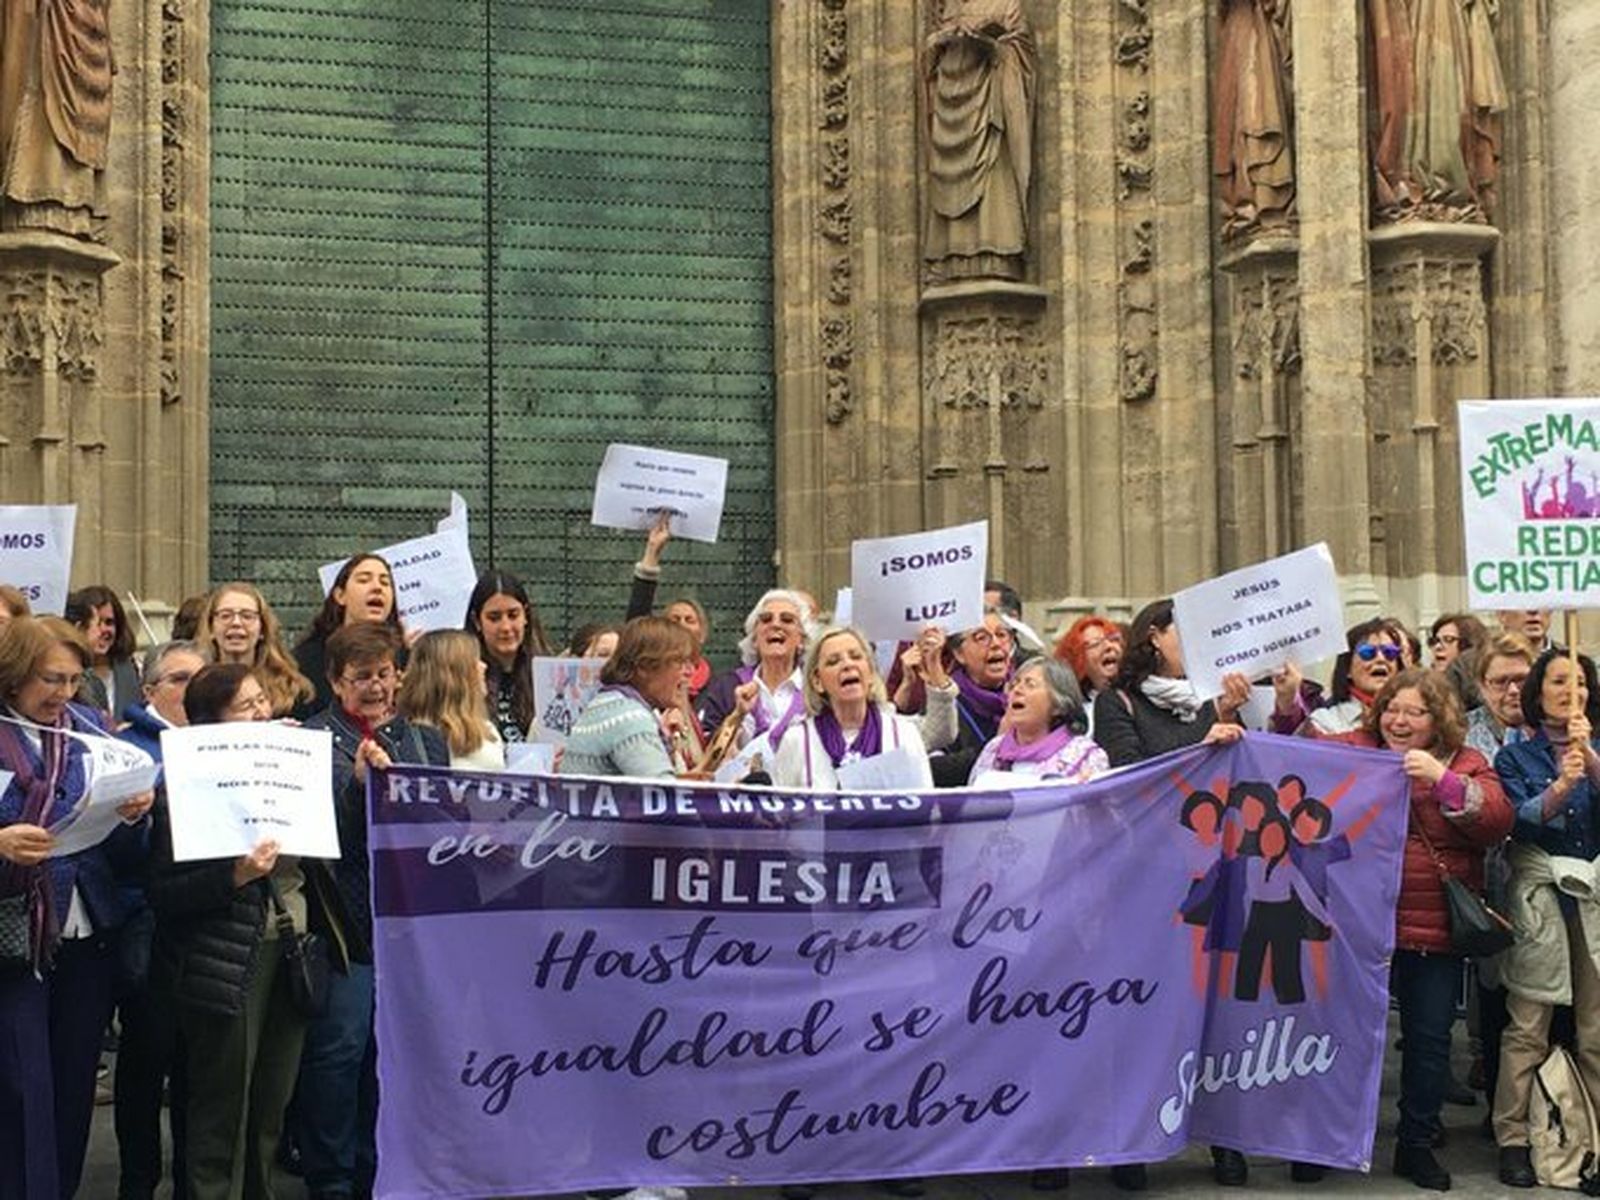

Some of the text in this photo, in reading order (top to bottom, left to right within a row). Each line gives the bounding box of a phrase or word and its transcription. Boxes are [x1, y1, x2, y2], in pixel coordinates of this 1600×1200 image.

[1469, 413, 1600, 498] EXTREMA
[0, 533, 46, 549] MOS
[393, 550, 442, 569] ALDAD
[881, 545, 973, 577] ¡SOMOS
[1474, 561, 1600, 594] CRISTIA
[399, 599, 440, 617] ECHO
[904, 600, 957, 622] LUZ!
[1211, 621, 1243, 639] NOS
[1214, 627, 1322, 669] COMO IGUALES
[642, 786, 698, 816] DE
[427, 810, 611, 869] en la
[651, 857, 897, 905] IGLESIA
[533, 882, 1043, 991] Hasta que la
[459, 955, 1159, 1116] igualdad se haga
[1158, 1014, 1342, 1137] Svilla
[645, 1062, 1031, 1160] costumbre
